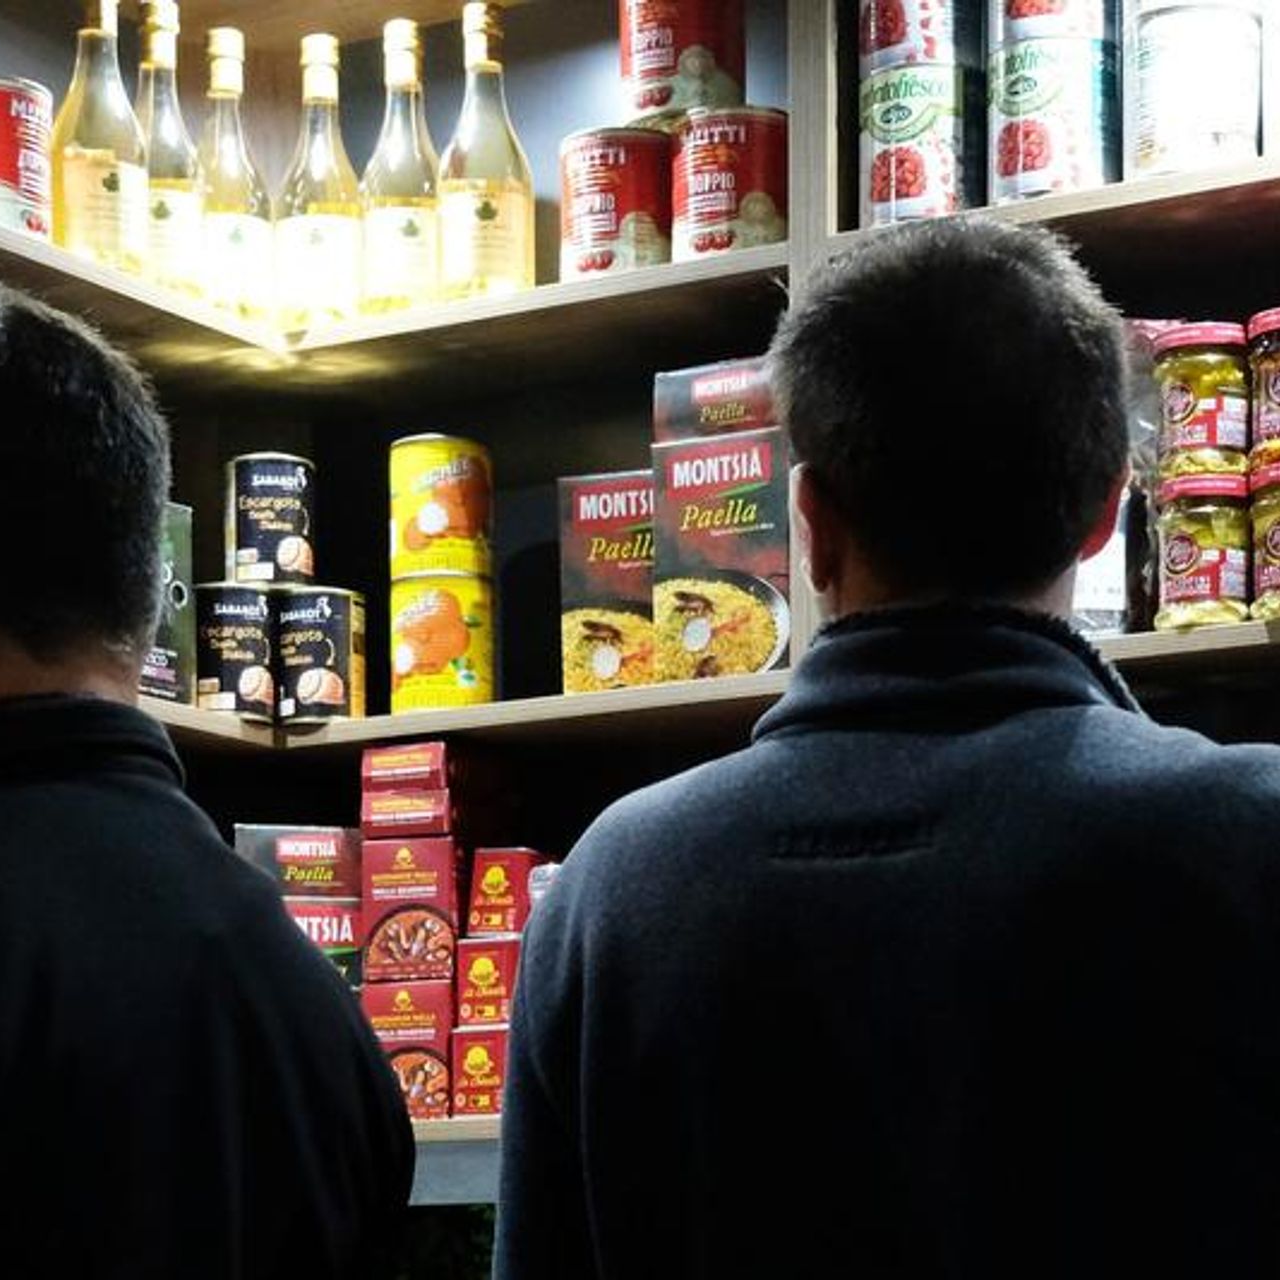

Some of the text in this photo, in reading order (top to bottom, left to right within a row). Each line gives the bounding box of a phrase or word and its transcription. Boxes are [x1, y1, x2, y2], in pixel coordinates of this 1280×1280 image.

[578, 487, 656, 522] MONTSI
[679, 498, 758, 533] Paella
[586, 535, 656, 564] Paell
[283, 863, 334, 884] Paella
